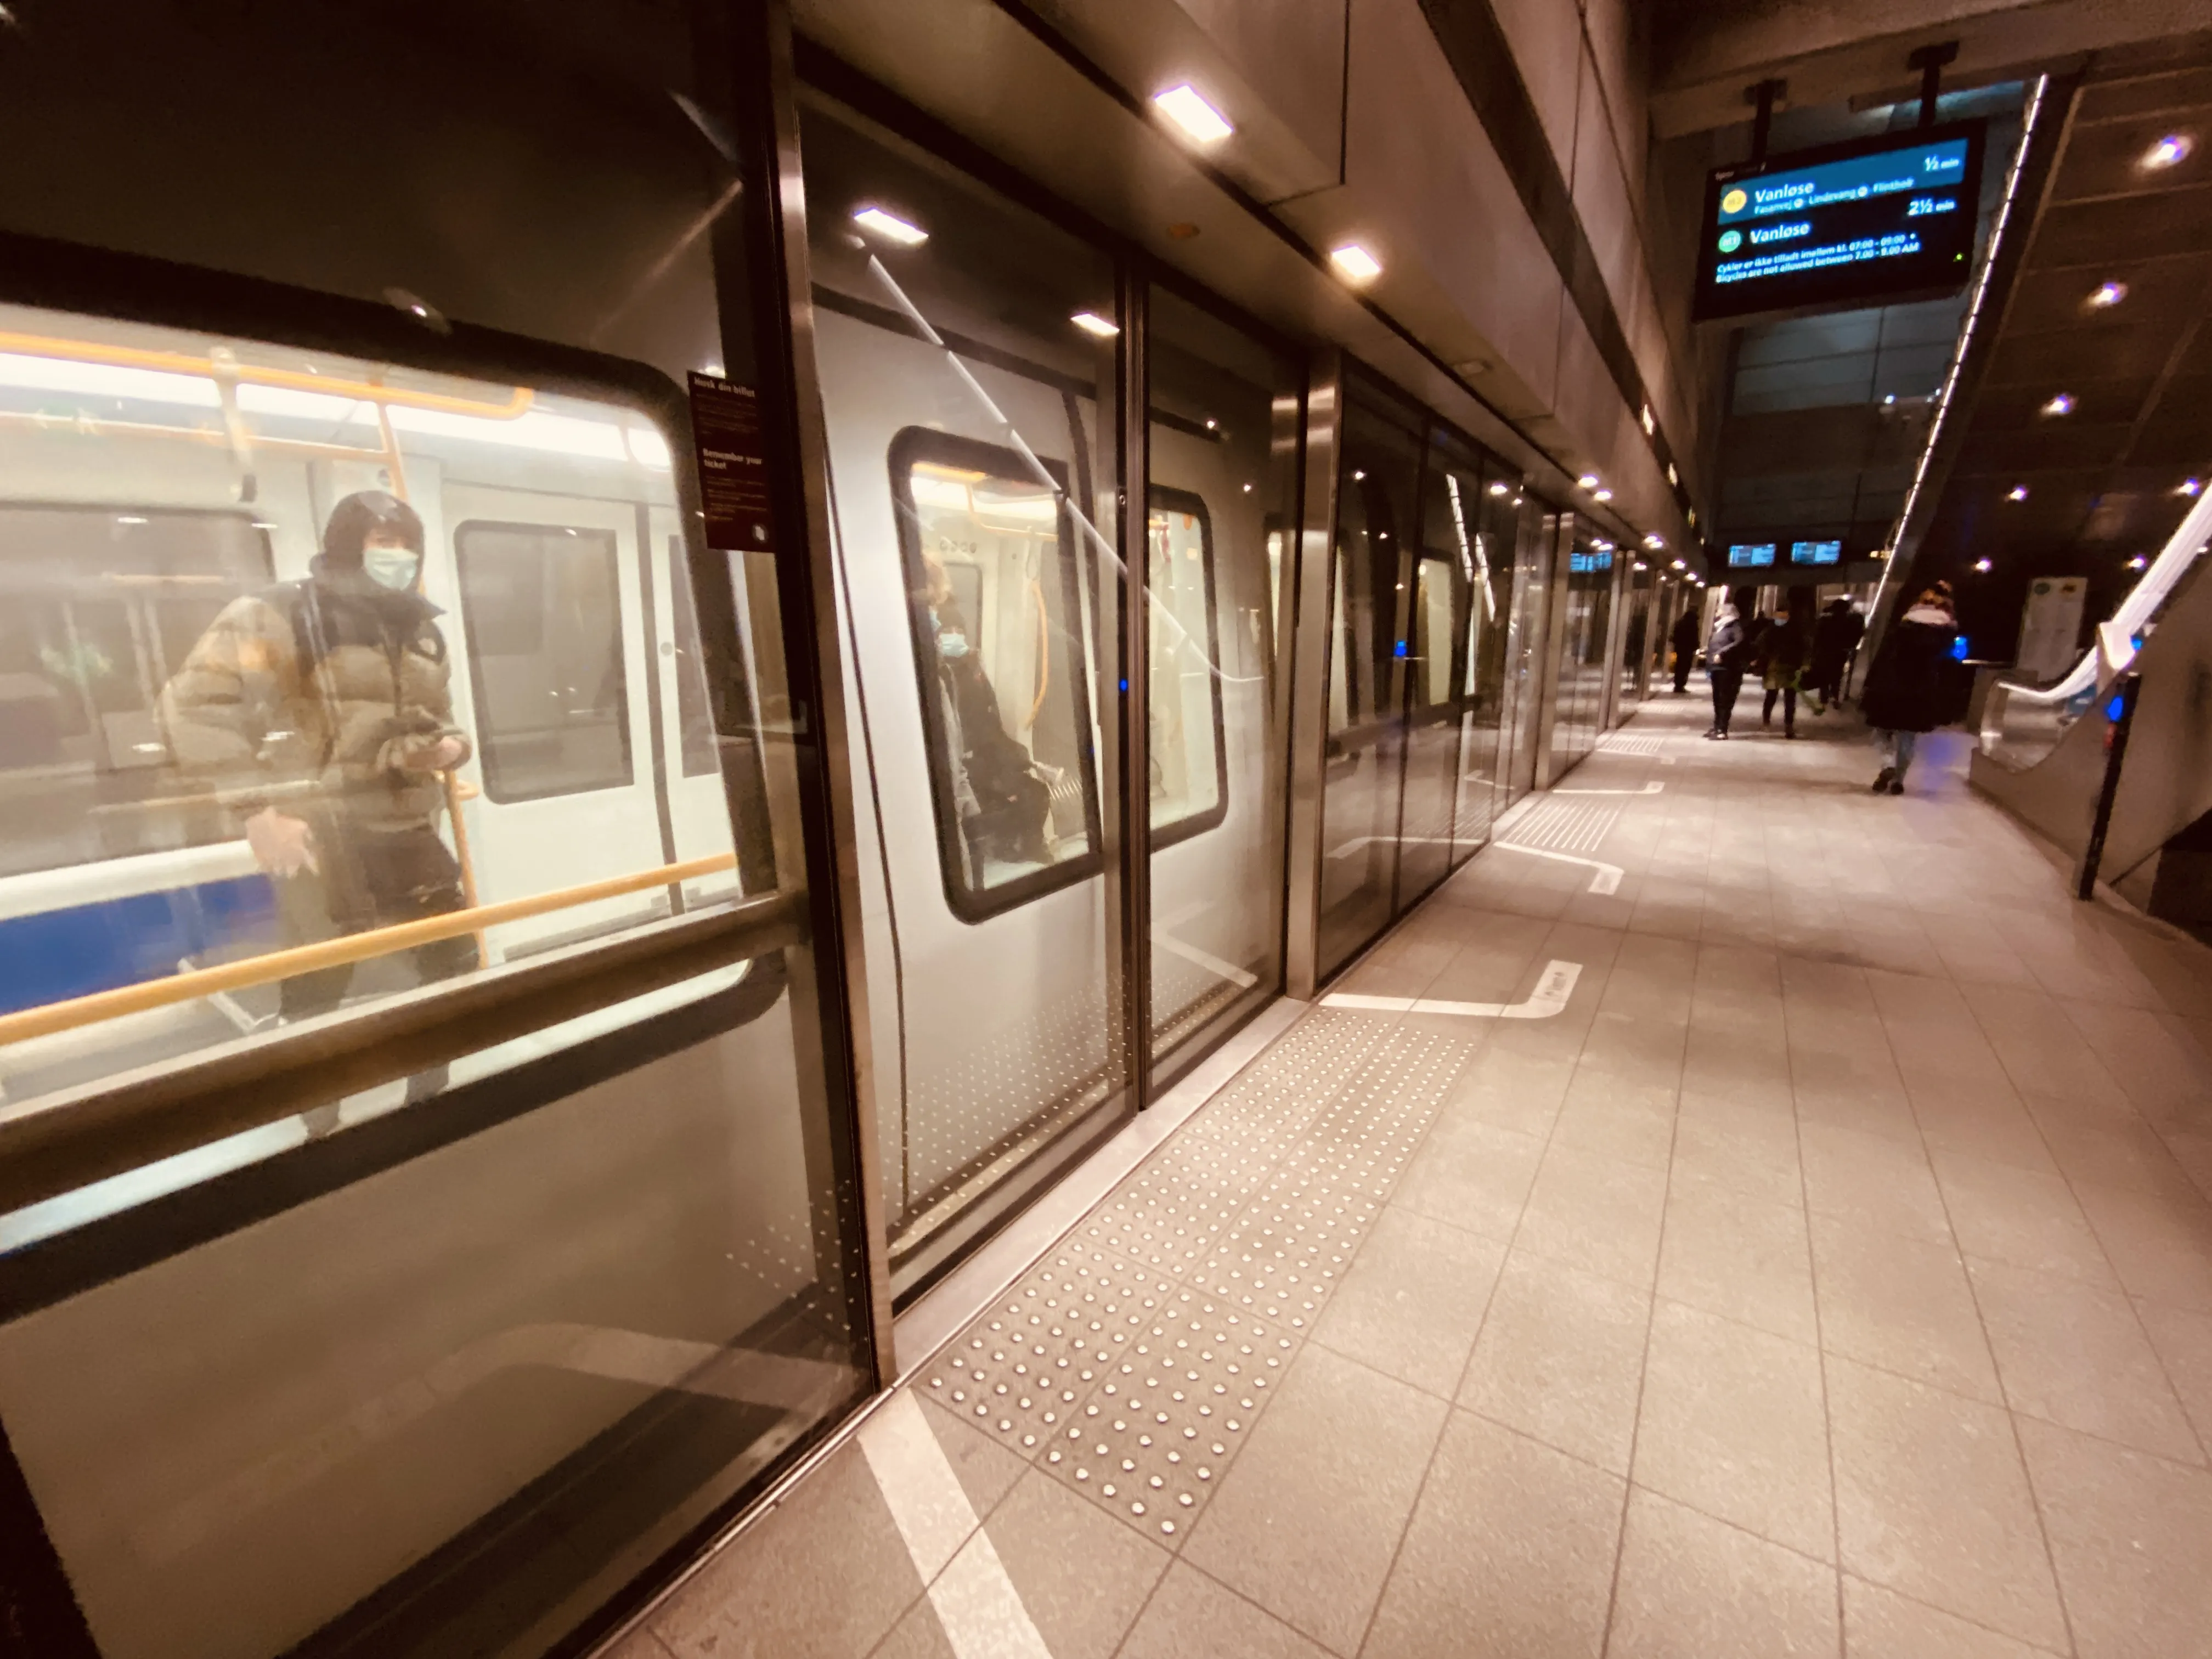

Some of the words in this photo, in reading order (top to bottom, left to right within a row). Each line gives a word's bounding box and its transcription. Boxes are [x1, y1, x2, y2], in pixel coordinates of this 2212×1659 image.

[1940, 158, 1960, 169] min
[1754, 182, 1814, 202] Vanløse
[1935, 200, 1956, 212] min
[1750, 222, 1810, 244] Vanløse
[1748, 268, 1763, 278] are
[1763, 266, 1779, 275] not
[1780, 259, 1814, 272] allowed
[1754, 257, 1773, 267] ikke
